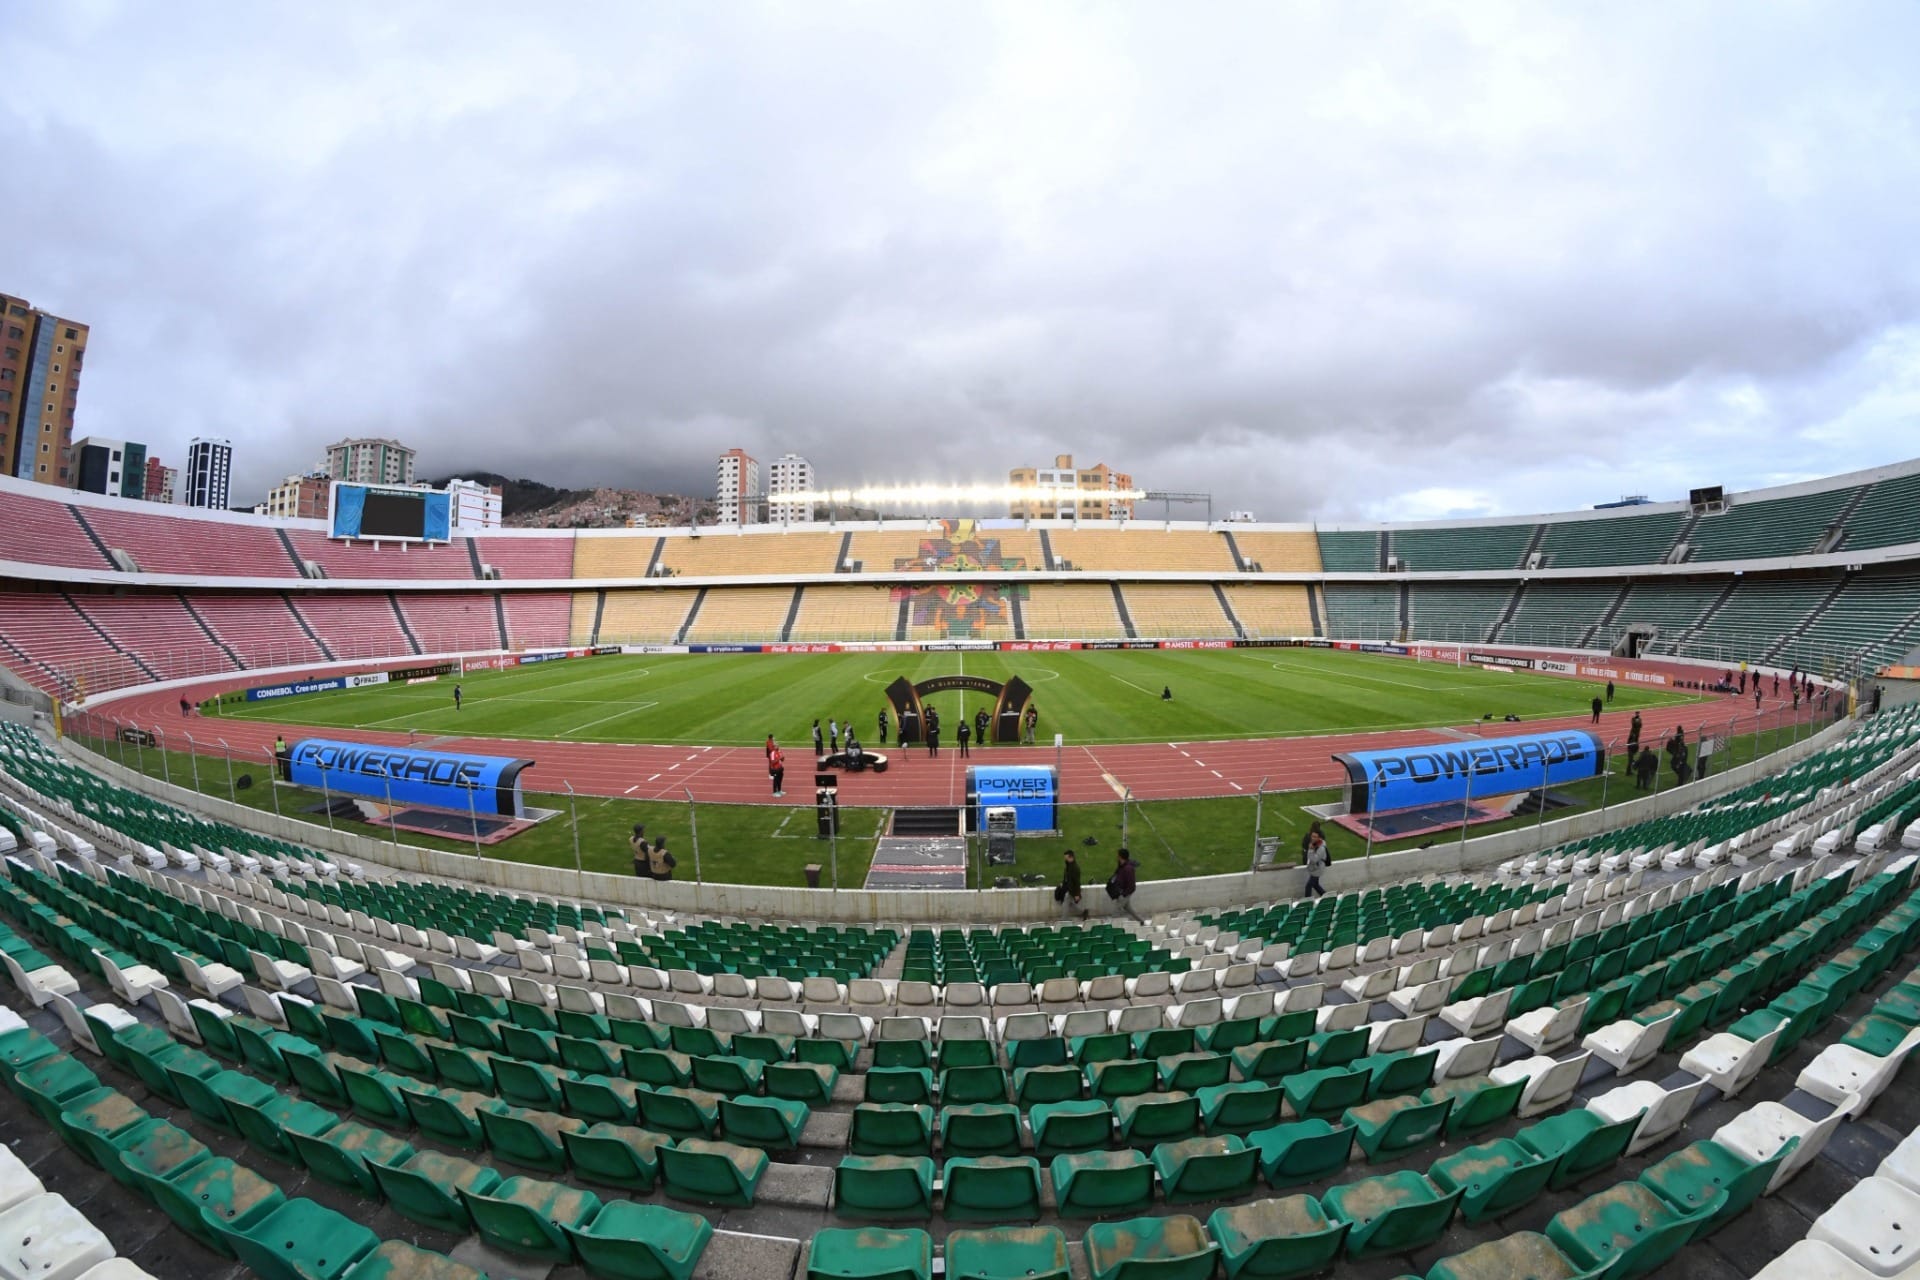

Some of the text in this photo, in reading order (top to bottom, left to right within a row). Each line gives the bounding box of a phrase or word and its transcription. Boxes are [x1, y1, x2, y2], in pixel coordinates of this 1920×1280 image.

[1170, 641, 1195, 649] AMSTEL
[1204, 641, 1227, 649] AMSTEL
[256, 686, 294, 699] CONMEBOL
[295, 680, 310, 694] Cree
[318, 680, 339, 692] grande
[297, 743, 488, 790] POWERADE
[1373, 737, 1585, 788] POWERADE
[978, 777, 1048, 789] POWER
[1007, 787, 1048, 801] ADE
